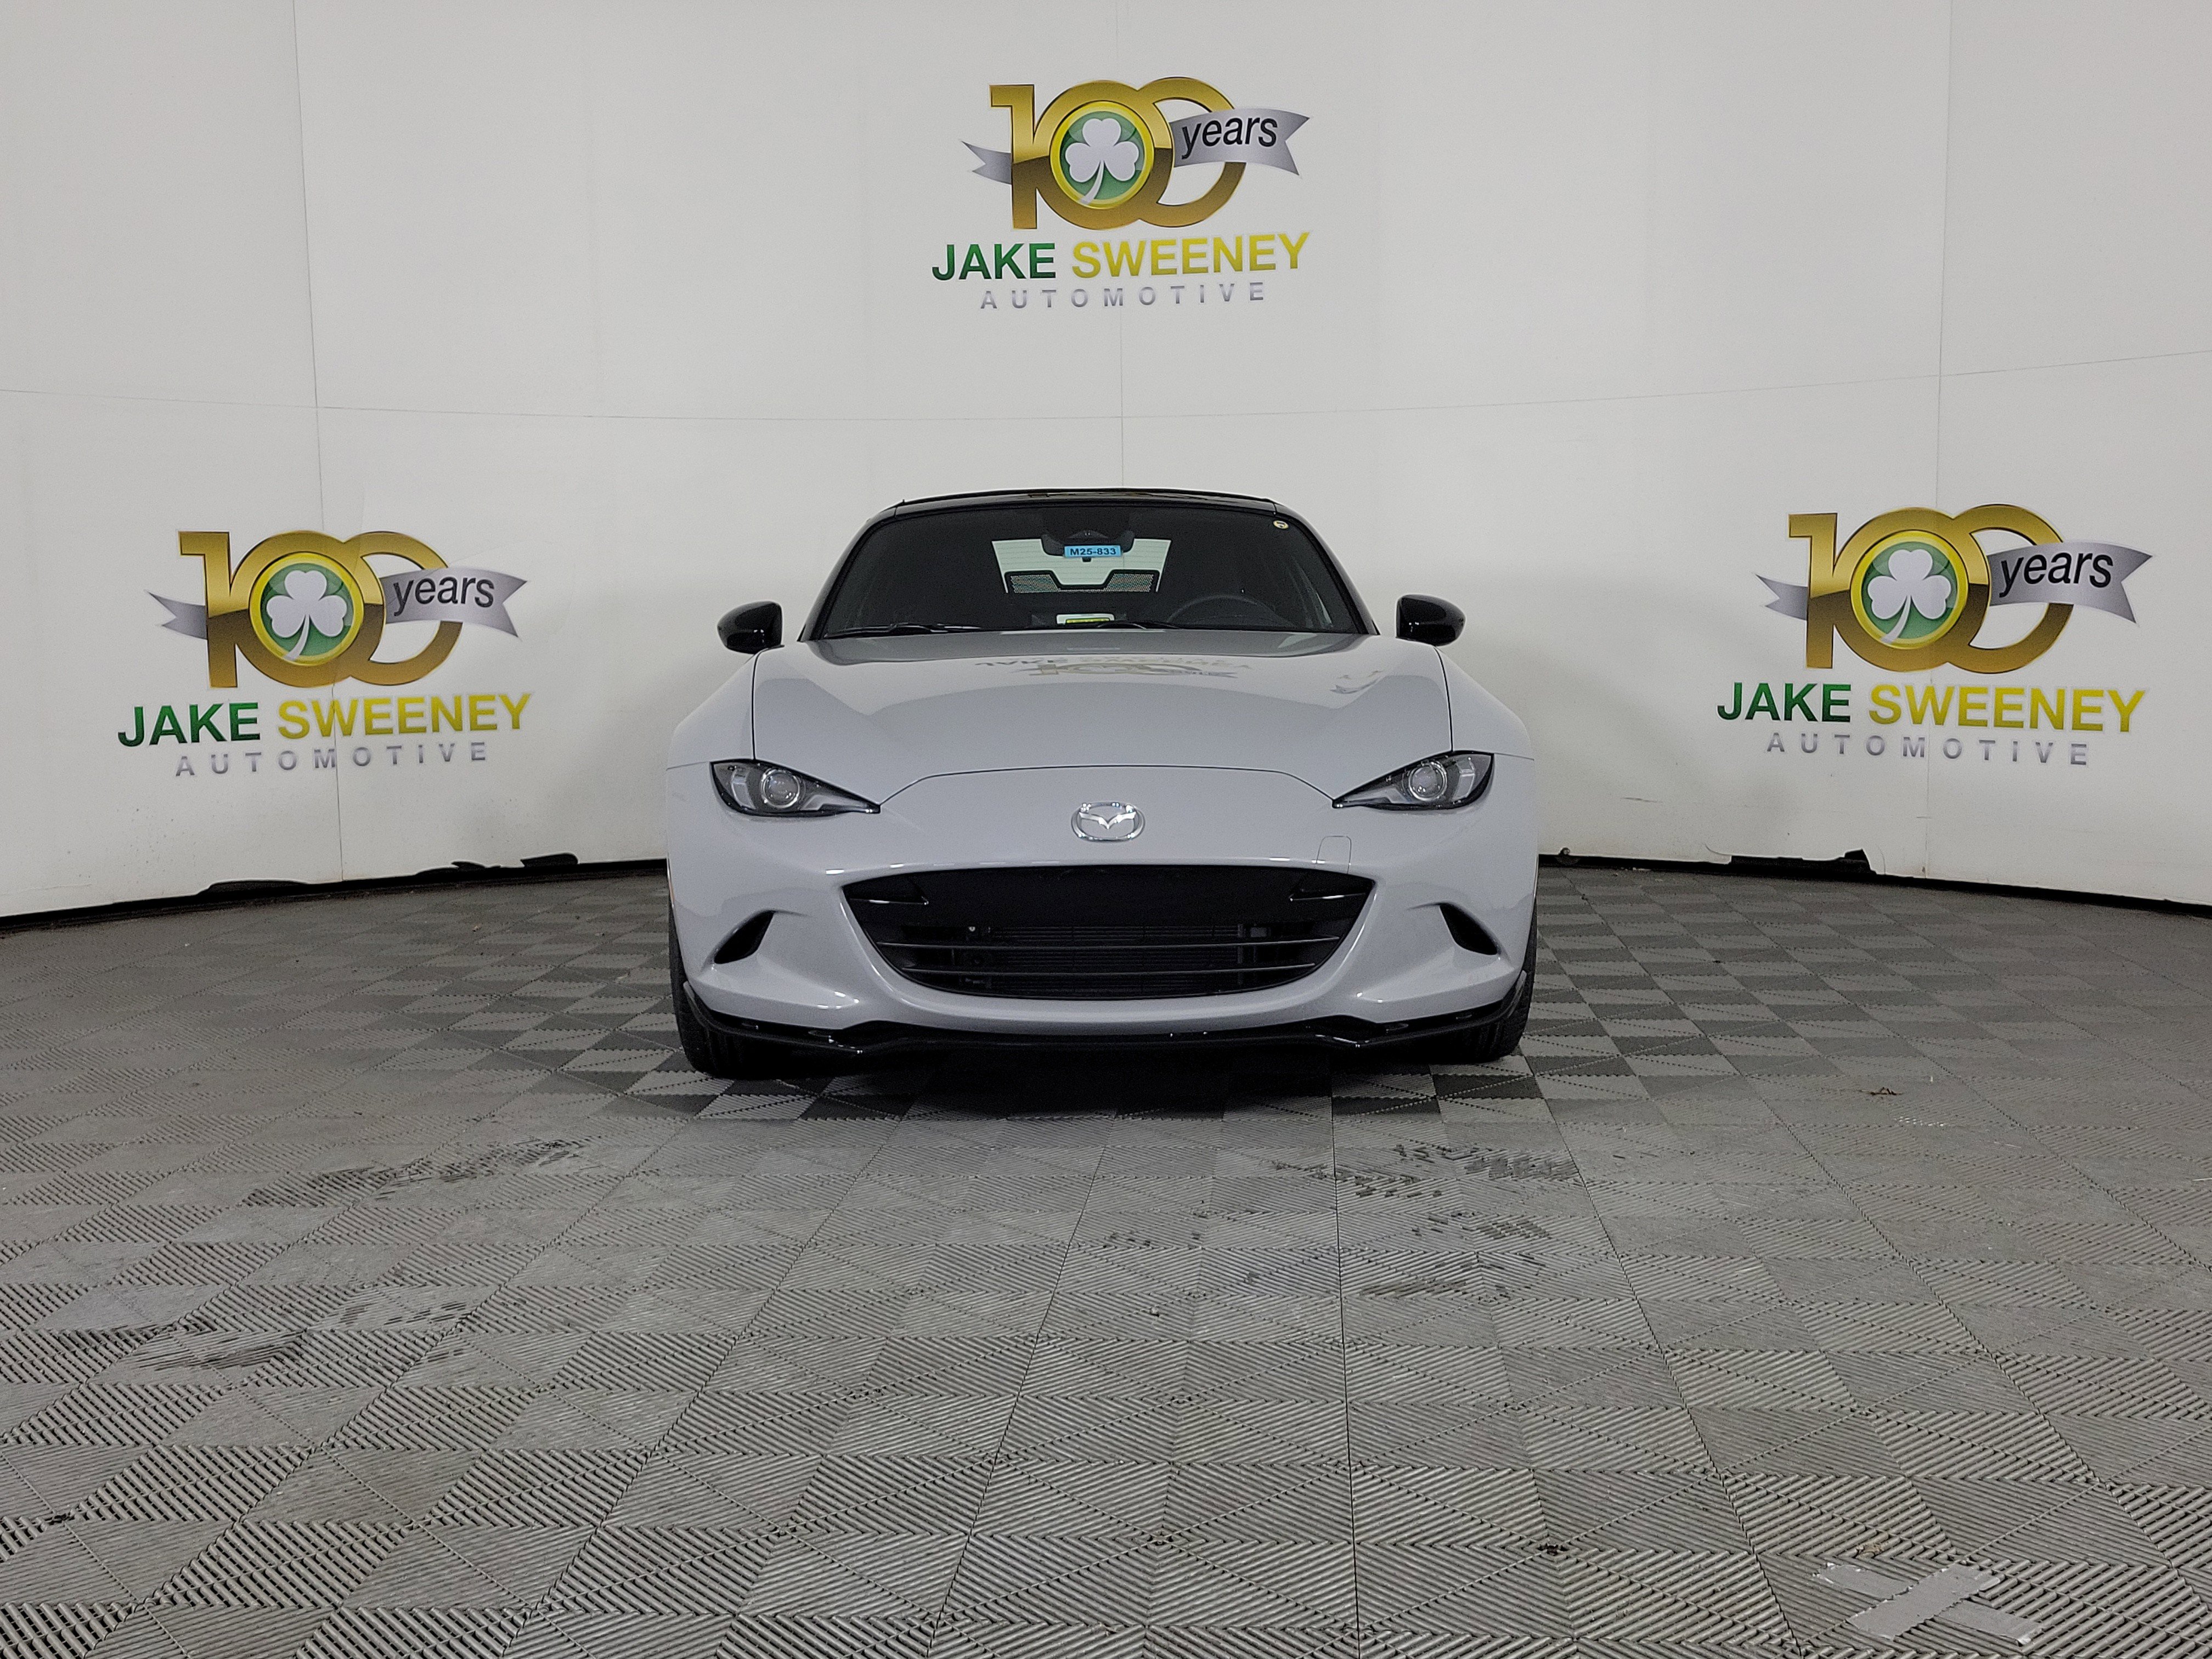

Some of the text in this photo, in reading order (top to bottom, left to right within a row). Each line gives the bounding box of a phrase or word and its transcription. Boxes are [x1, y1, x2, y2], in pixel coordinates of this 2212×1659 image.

[990, 77, 1278, 230] 100 years
[932, 232, 1311, 280] JAKE SWEENEY
[980, 282, 1264, 309] AUTOMOTIVE
[1070, 548, 1116, 556] M25-833
[178, 531, 495, 688] 100 years
[1788, 504, 2113, 674] 100 years
[118, 693, 531, 747] JAKE SWEENEY
[1718, 682, 2145, 732] JAKE SWEENEY
[176, 742, 486, 777] AUTOMOTIVE
[1767, 733, 2088, 765] AUTOMOTIVE
